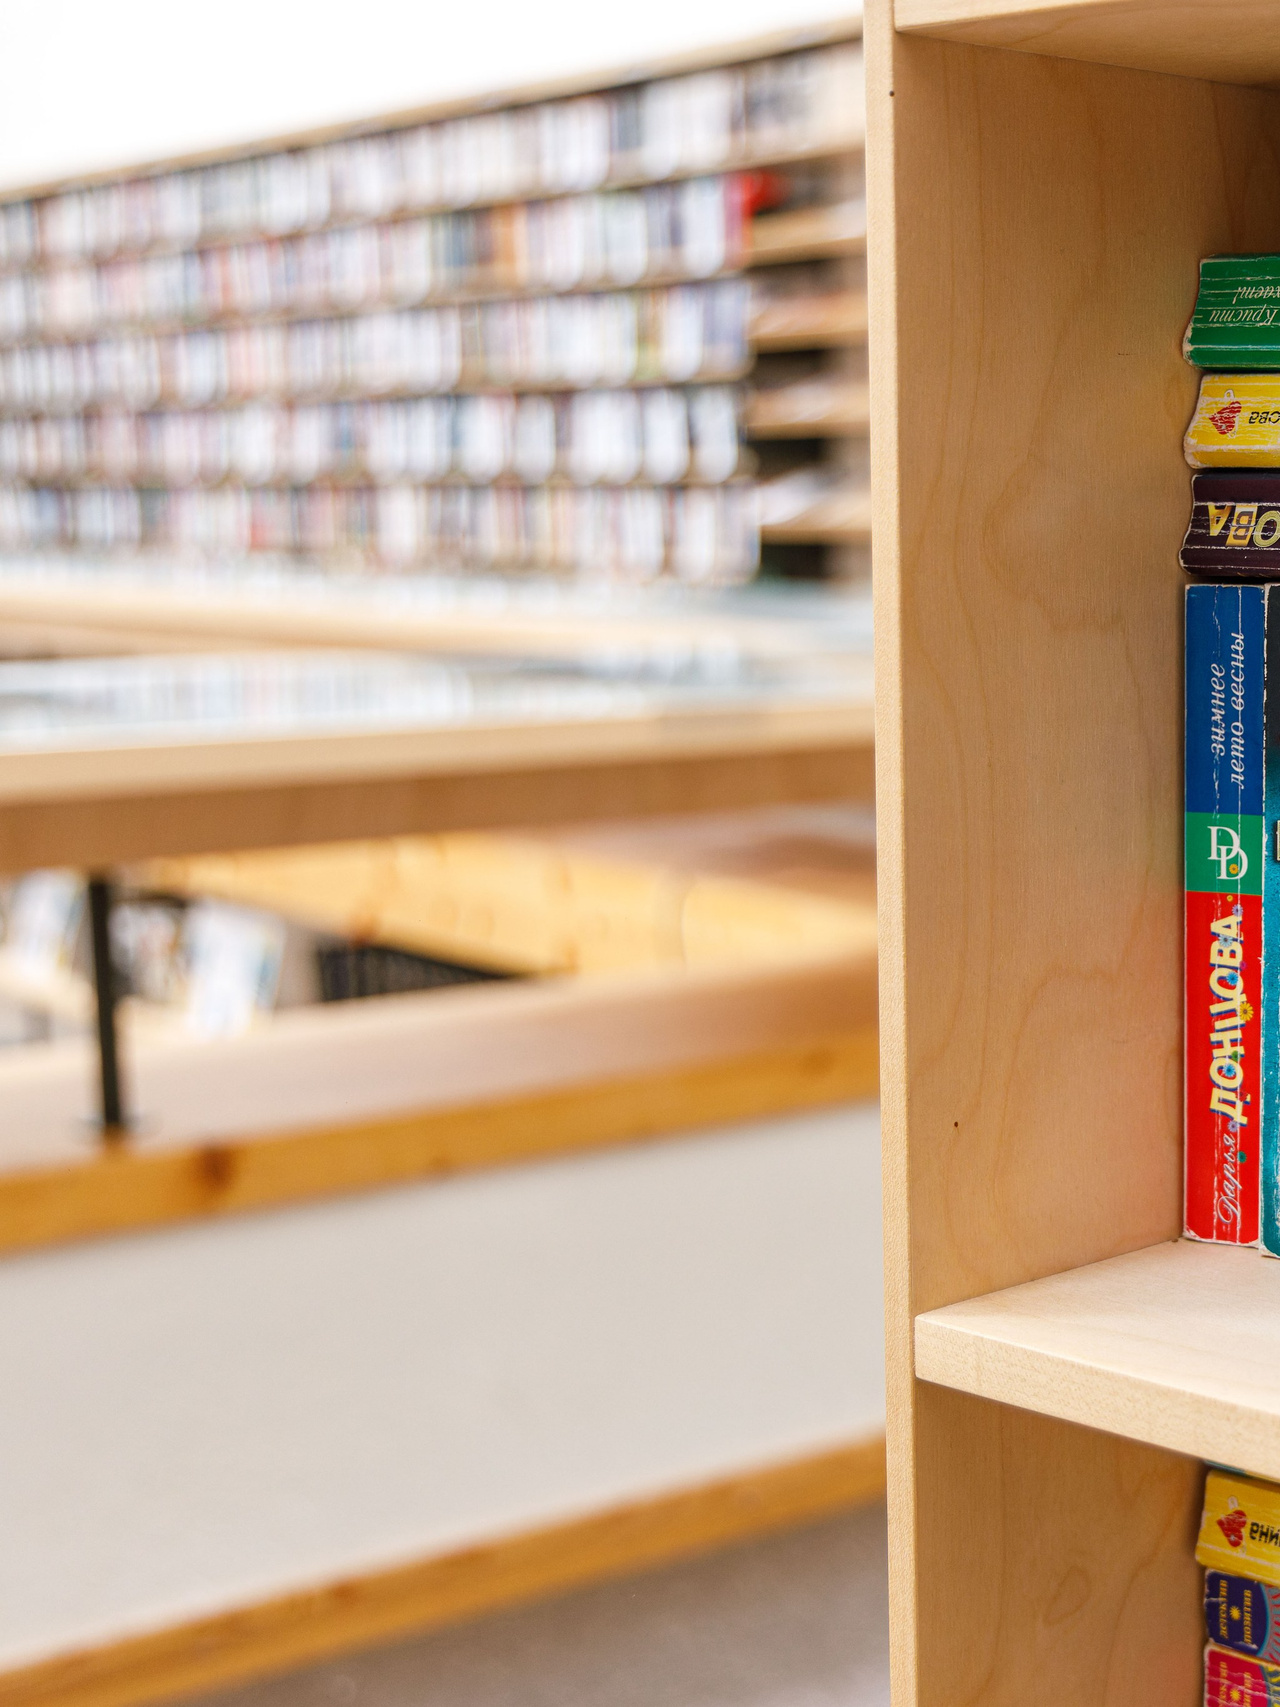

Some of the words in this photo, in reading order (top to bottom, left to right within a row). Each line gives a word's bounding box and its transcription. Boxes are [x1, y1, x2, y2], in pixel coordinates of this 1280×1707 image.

[1209, 304, 1272, 325] Кристи
[1210, 663, 1227, 757] зимнее
[1230, 632, 1246, 712] весны
[1230, 722, 1246, 790] лето
[1209, 914, 1251, 1128] ДОНЦОВА
